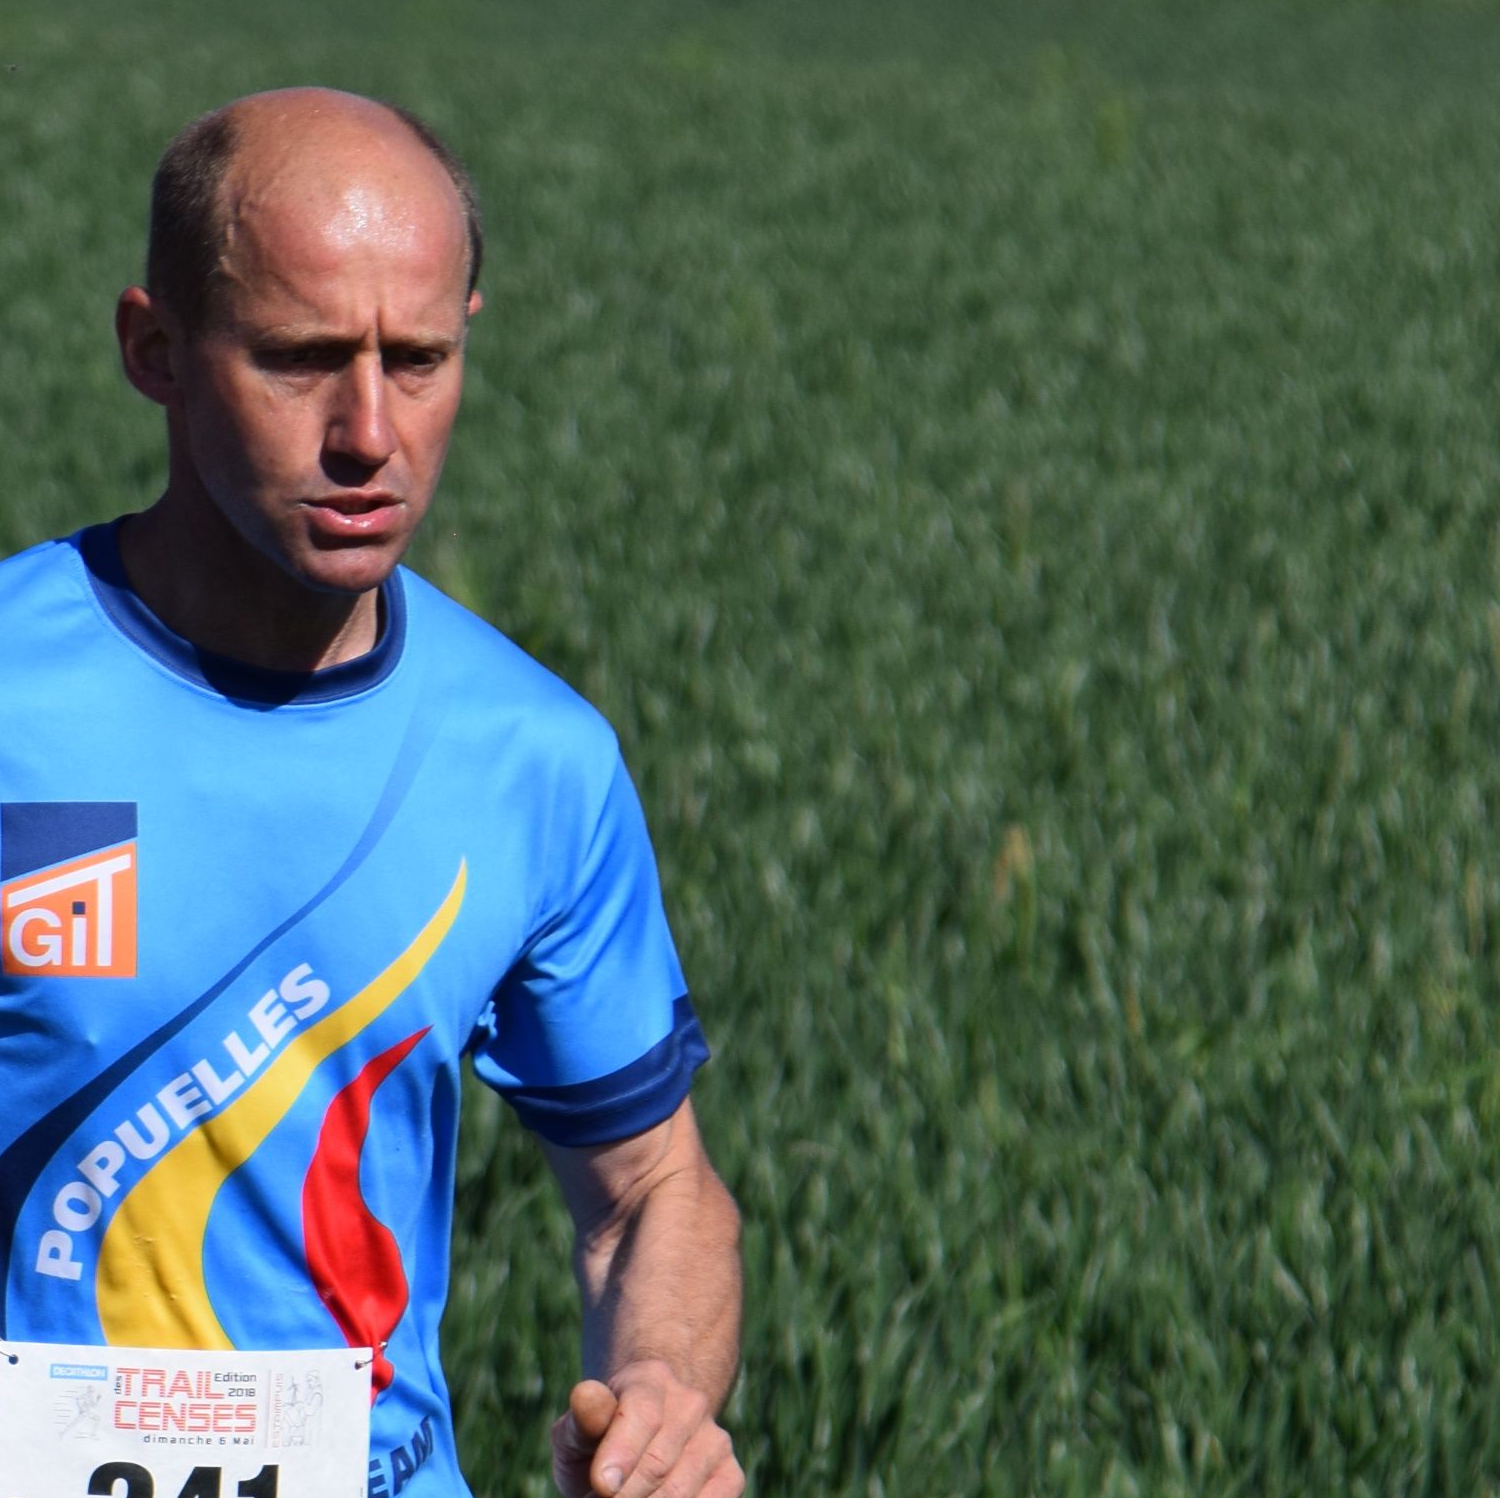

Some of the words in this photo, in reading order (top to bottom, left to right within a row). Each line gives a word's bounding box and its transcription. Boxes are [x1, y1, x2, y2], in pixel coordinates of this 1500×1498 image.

[35, 962, 332, 1281] POPUELLES
[52, 1366, 106, 1378] DECATHLON
[214, 1372, 257, 1383] Edition
[113, 1374, 123, 1395] des
[116, 1367, 225, 1399] TRAIL
[227, 1387, 256, 1398] 2018
[114, 1400, 257, 1433] CENSES
[143, 1434, 213, 1446] dimanche
[219, 1436, 227, 1446] 6
[233, 1436, 255, 1446] Mai
